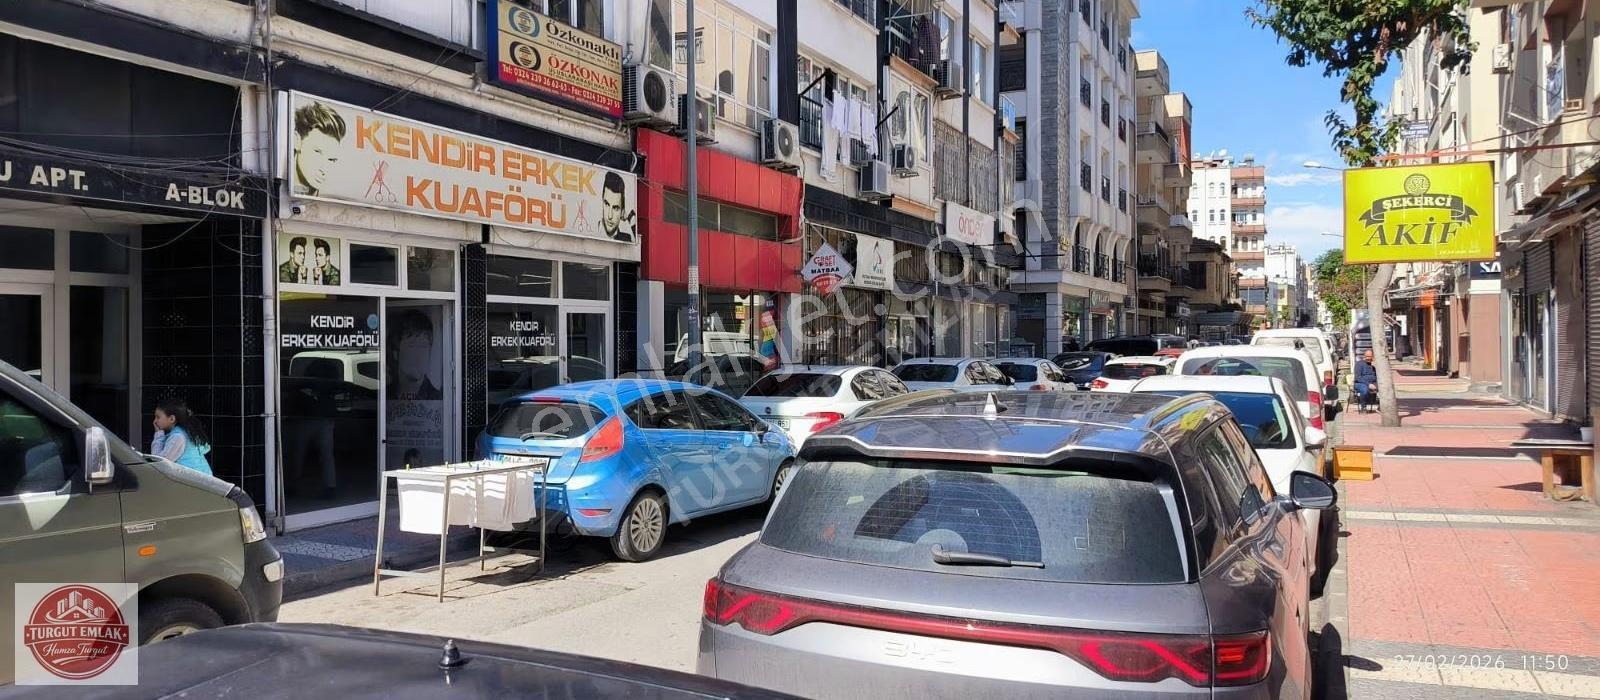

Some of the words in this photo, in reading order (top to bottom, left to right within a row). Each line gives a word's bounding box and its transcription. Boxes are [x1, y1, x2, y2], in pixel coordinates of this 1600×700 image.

[545, 19, 619, 60] Özkonaklı
[503, 63, 513, 75] Tel:
[547, 53, 619, 90] ÖZKONAK
[30, 165, 89, 191] APT.
[165, 183, 245, 210] A-BLOK
[502, 149, 597, 196] ERKEK
[406, 175, 567, 229] KUAFÖRÜ
[1382, 196, 1453, 210] ŞEKERCİ
[1364, 216, 1463, 246] AKİF
[811, 266, 840, 274] MATBAA
[281, 334, 323, 347] ERKEK
[324, 331, 380, 347] KUAFÖRÜ
[491, 336, 518, 347] ERKEK
[519, 332, 556, 347] KUAFÖRÜ
